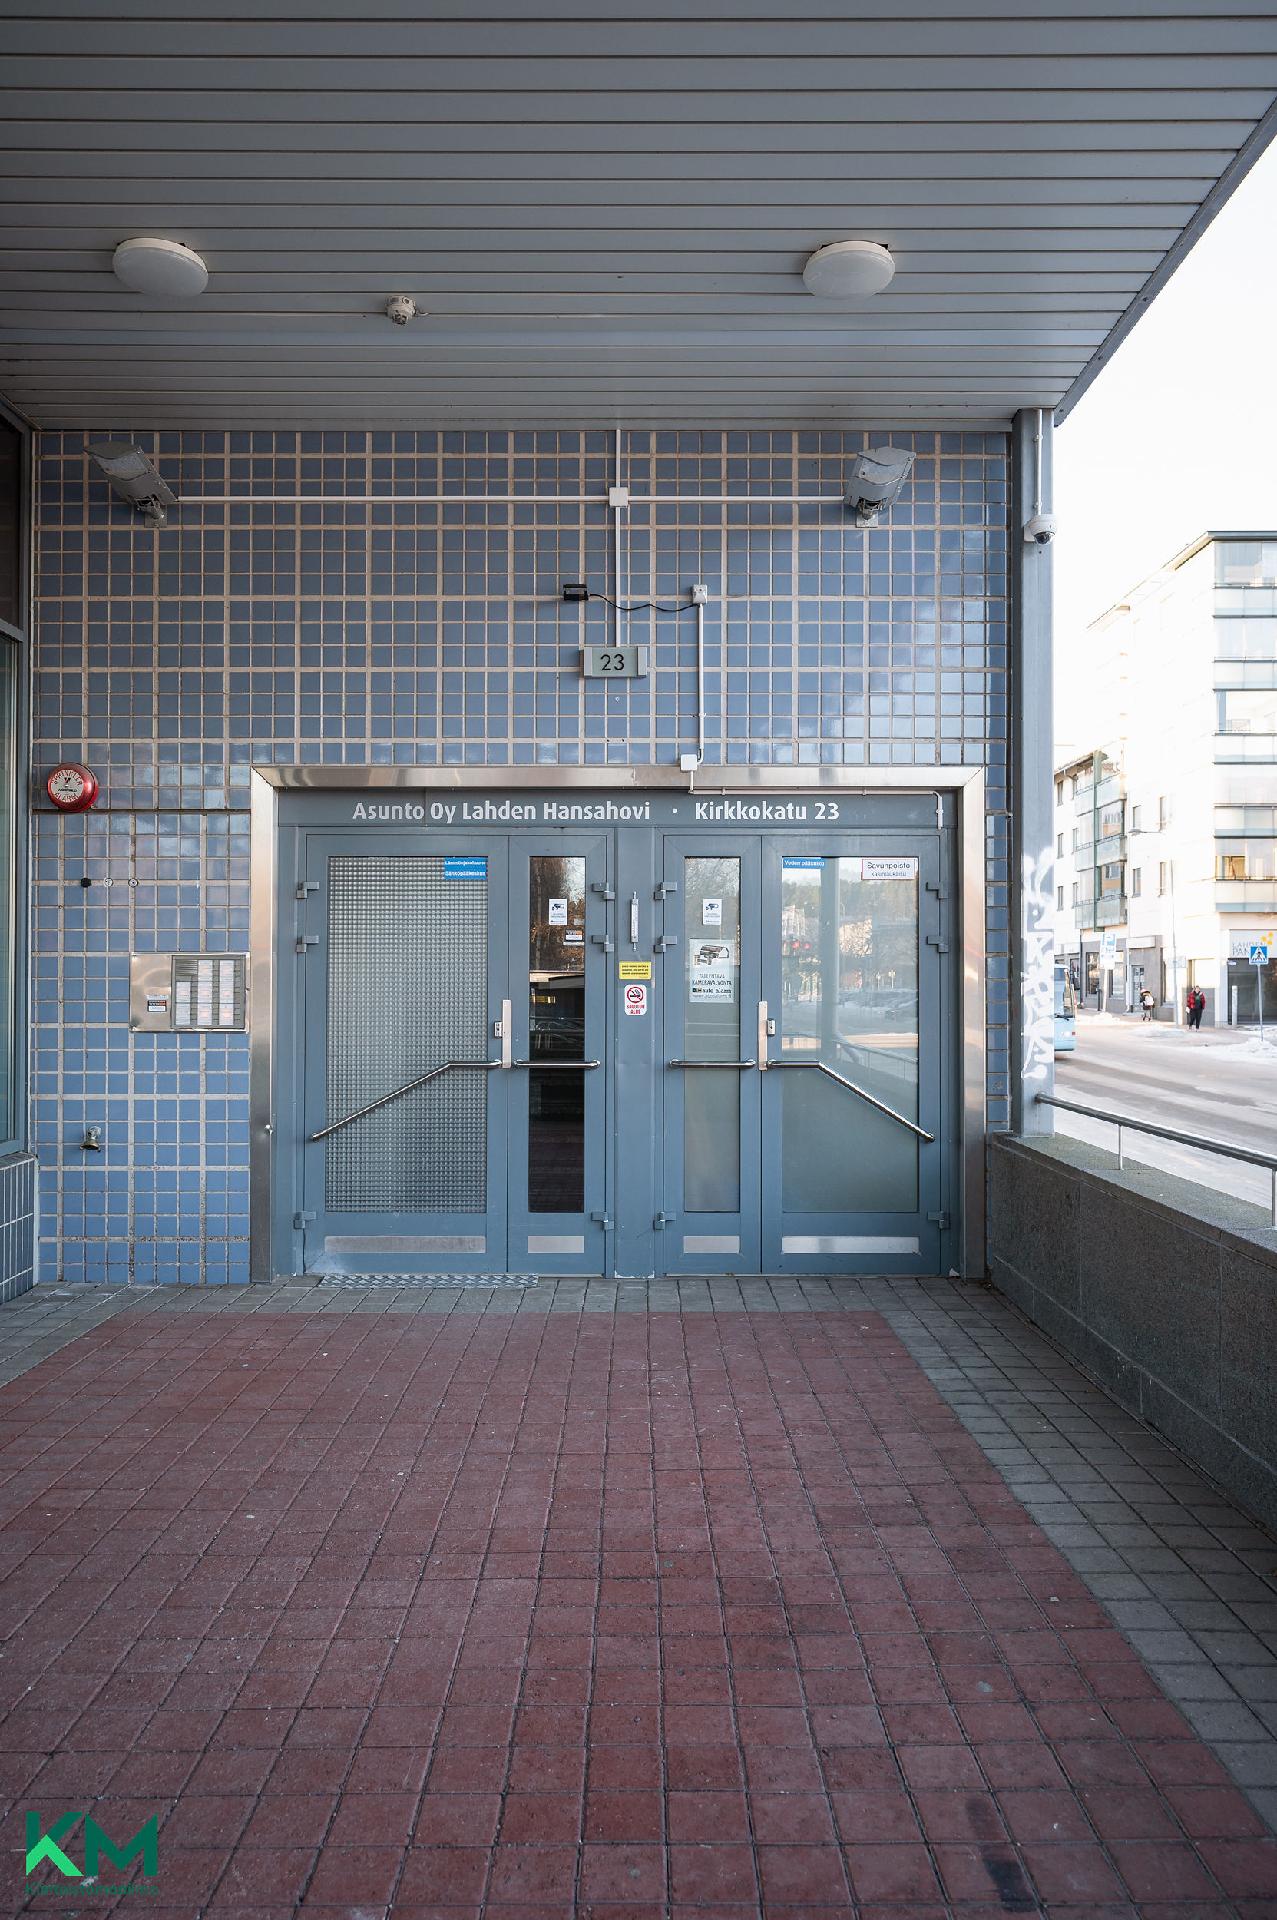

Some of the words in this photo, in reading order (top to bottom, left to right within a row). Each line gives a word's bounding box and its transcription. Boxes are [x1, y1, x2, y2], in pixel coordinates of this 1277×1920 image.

[600, 653, 625, 671] 23
[353, 802, 425, 821] Asunto
[430, 802, 456, 825] Oy
[462, 801, 537, 821] Lahden
[542, 801, 651, 821] Hansahovi
[695, 801, 807, 821] Kirkkokatu
[814, 802, 840, 820] 23
